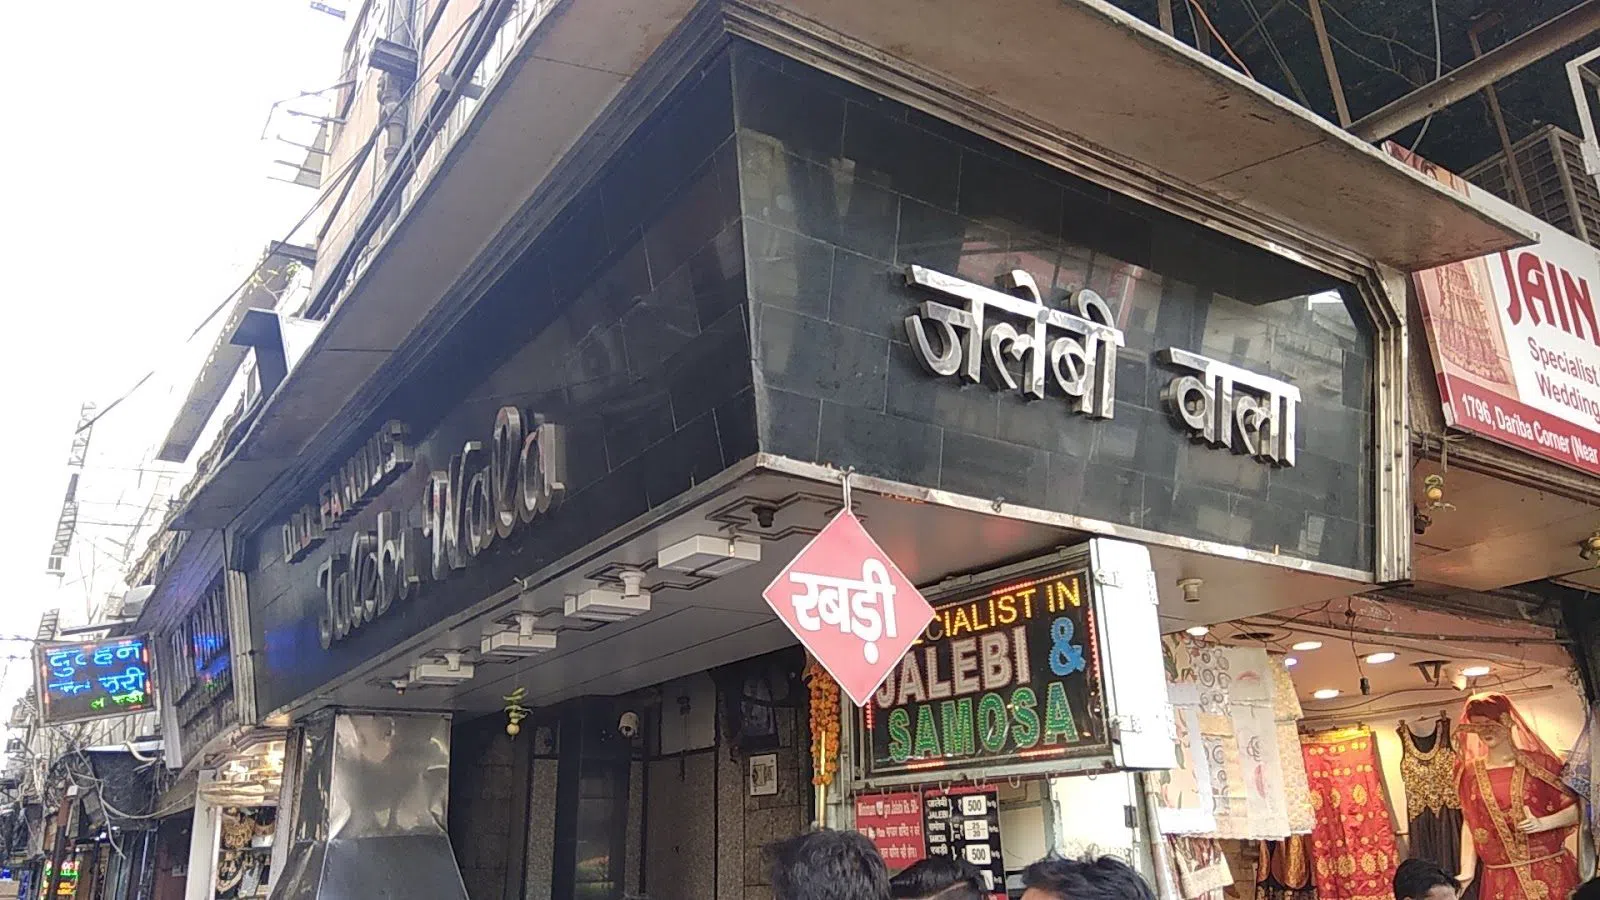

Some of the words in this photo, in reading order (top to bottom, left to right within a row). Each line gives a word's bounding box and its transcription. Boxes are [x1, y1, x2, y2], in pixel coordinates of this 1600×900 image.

[1499, 250, 1600, 347] JAIN
[905, 264, 1126, 420] जलेबी
[1158, 346, 1302, 468] वाला
[1527, 336, 1600, 388] Specialist
[1461, 393, 1497, 431] 1796,
[1495, 405, 1534, 441] Dariba
[1533, 420, 1571, 455] Corner
[1535, 371, 1600, 425] Wedding
[789, 558, 898, 664] रबड़ी
[912, 588, 1036, 645] CIALIST
[1043, 577, 1081, 613] IN
[876, 625, 1031, 709] JALEBI
[1050, 616, 1086, 677] &
[888, 681, 1080, 763] SAMOSA
[967, 799, 985, 812] 500
[971, 848, 987, 861] 500
